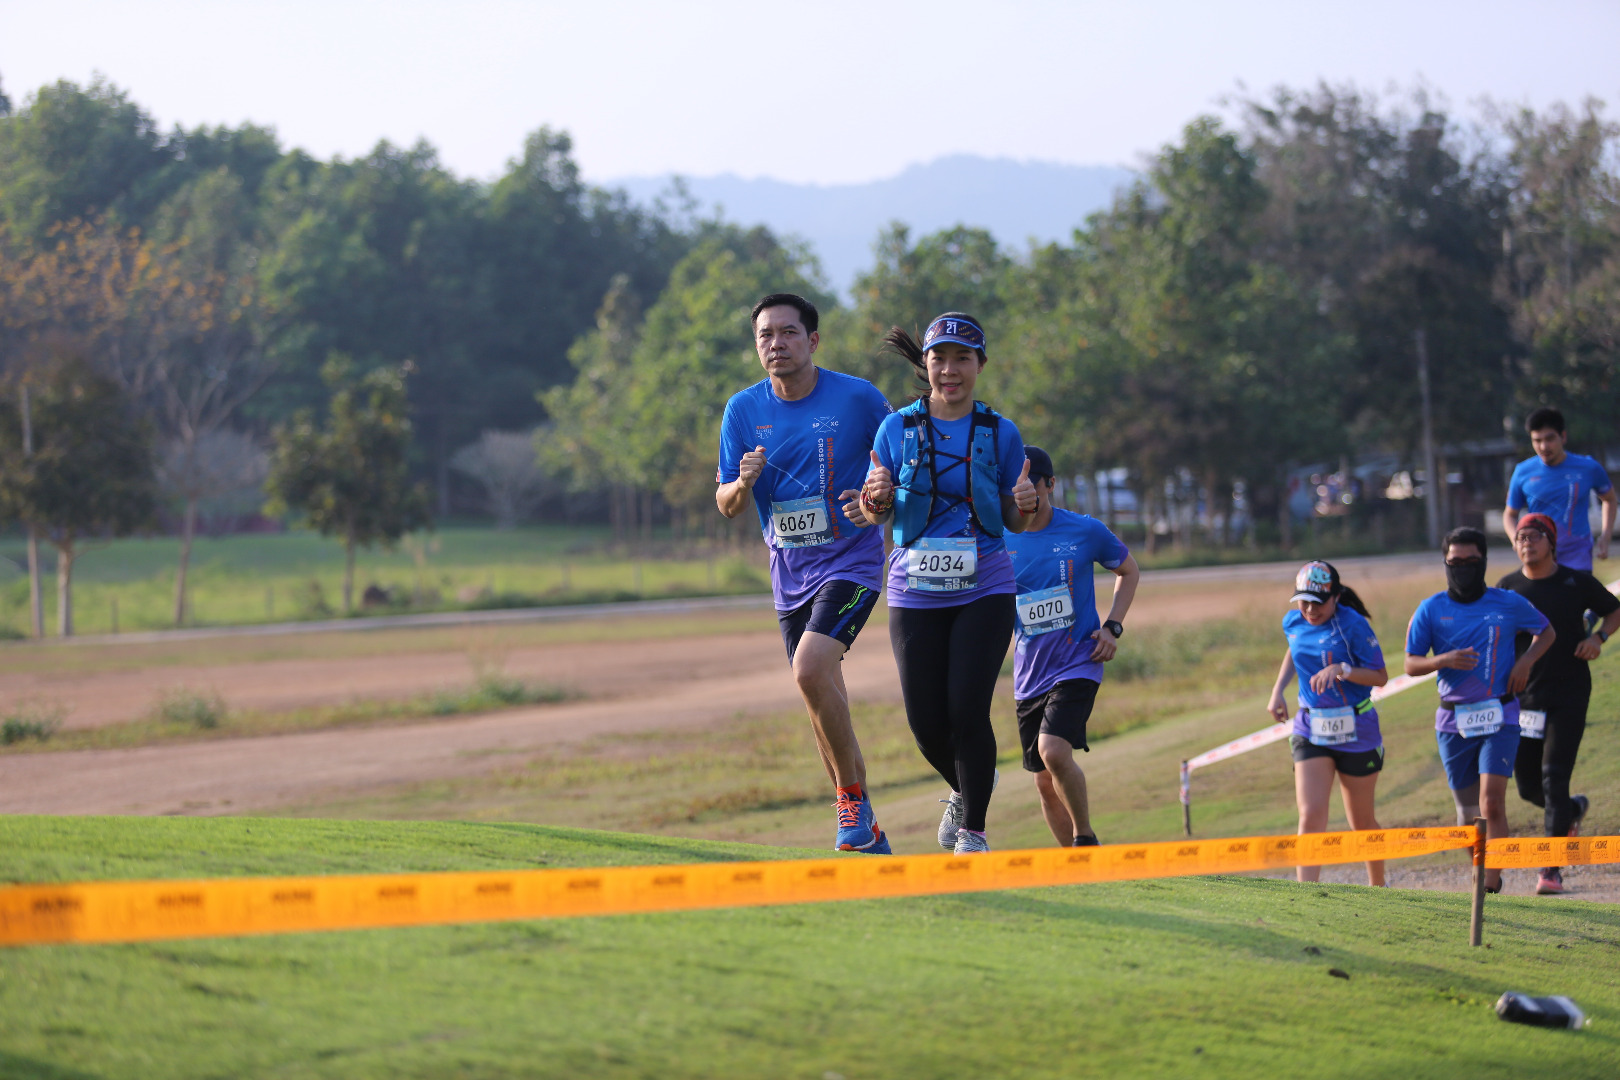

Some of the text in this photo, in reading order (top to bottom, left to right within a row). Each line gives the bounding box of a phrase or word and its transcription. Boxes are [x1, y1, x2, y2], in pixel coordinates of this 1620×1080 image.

[946, 323, 957, 334] 21
[828, 494, 838, 524] CHIANG
[780, 512, 815, 532] 6067
[919, 555, 964, 572] 6034
[1029, 600, 1063, 620] 6070
[1322, 719, 1344, 732] 6161
[1467, 711, 1494, 724] 6160
